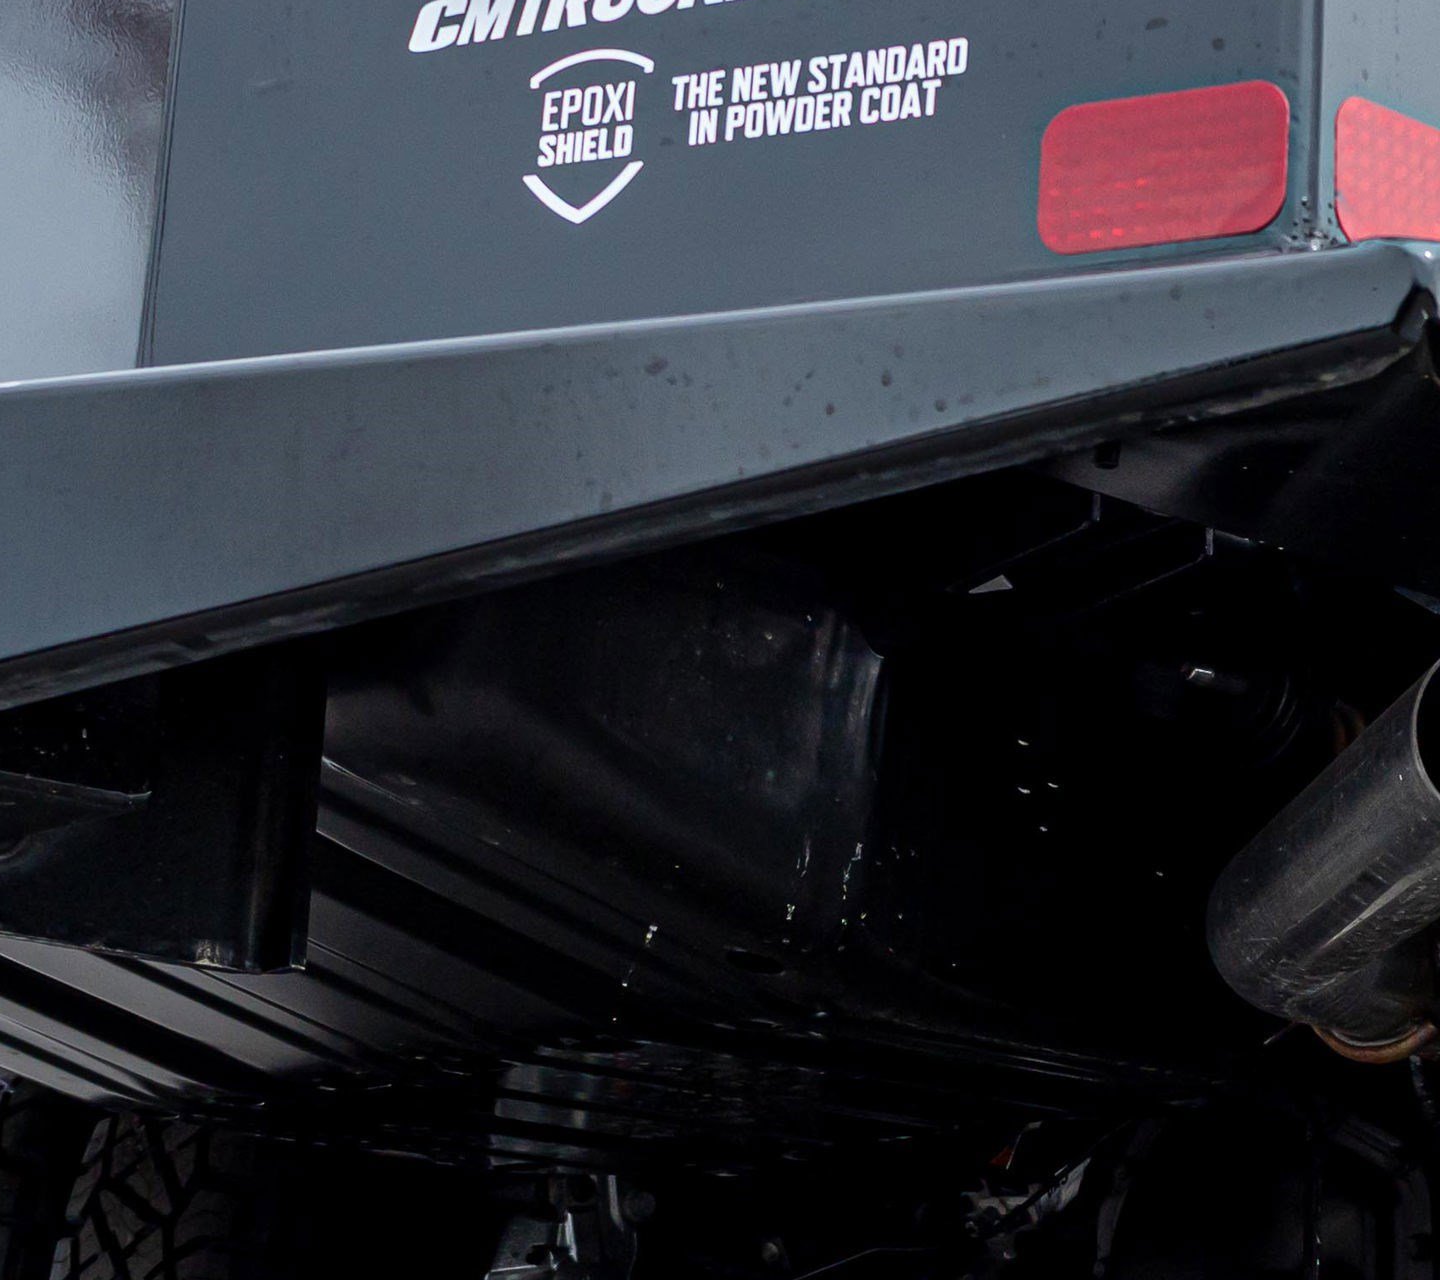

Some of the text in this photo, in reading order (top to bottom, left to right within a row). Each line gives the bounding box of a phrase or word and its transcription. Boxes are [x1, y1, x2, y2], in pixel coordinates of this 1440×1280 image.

[672, 37, 969, 111] THE NEW STANDARD
[541, 81, 636, 131] EPOXI
[688, 79, 942, 146] IN POWDER COAT
[537, 124, 634, 167] SHIELD
